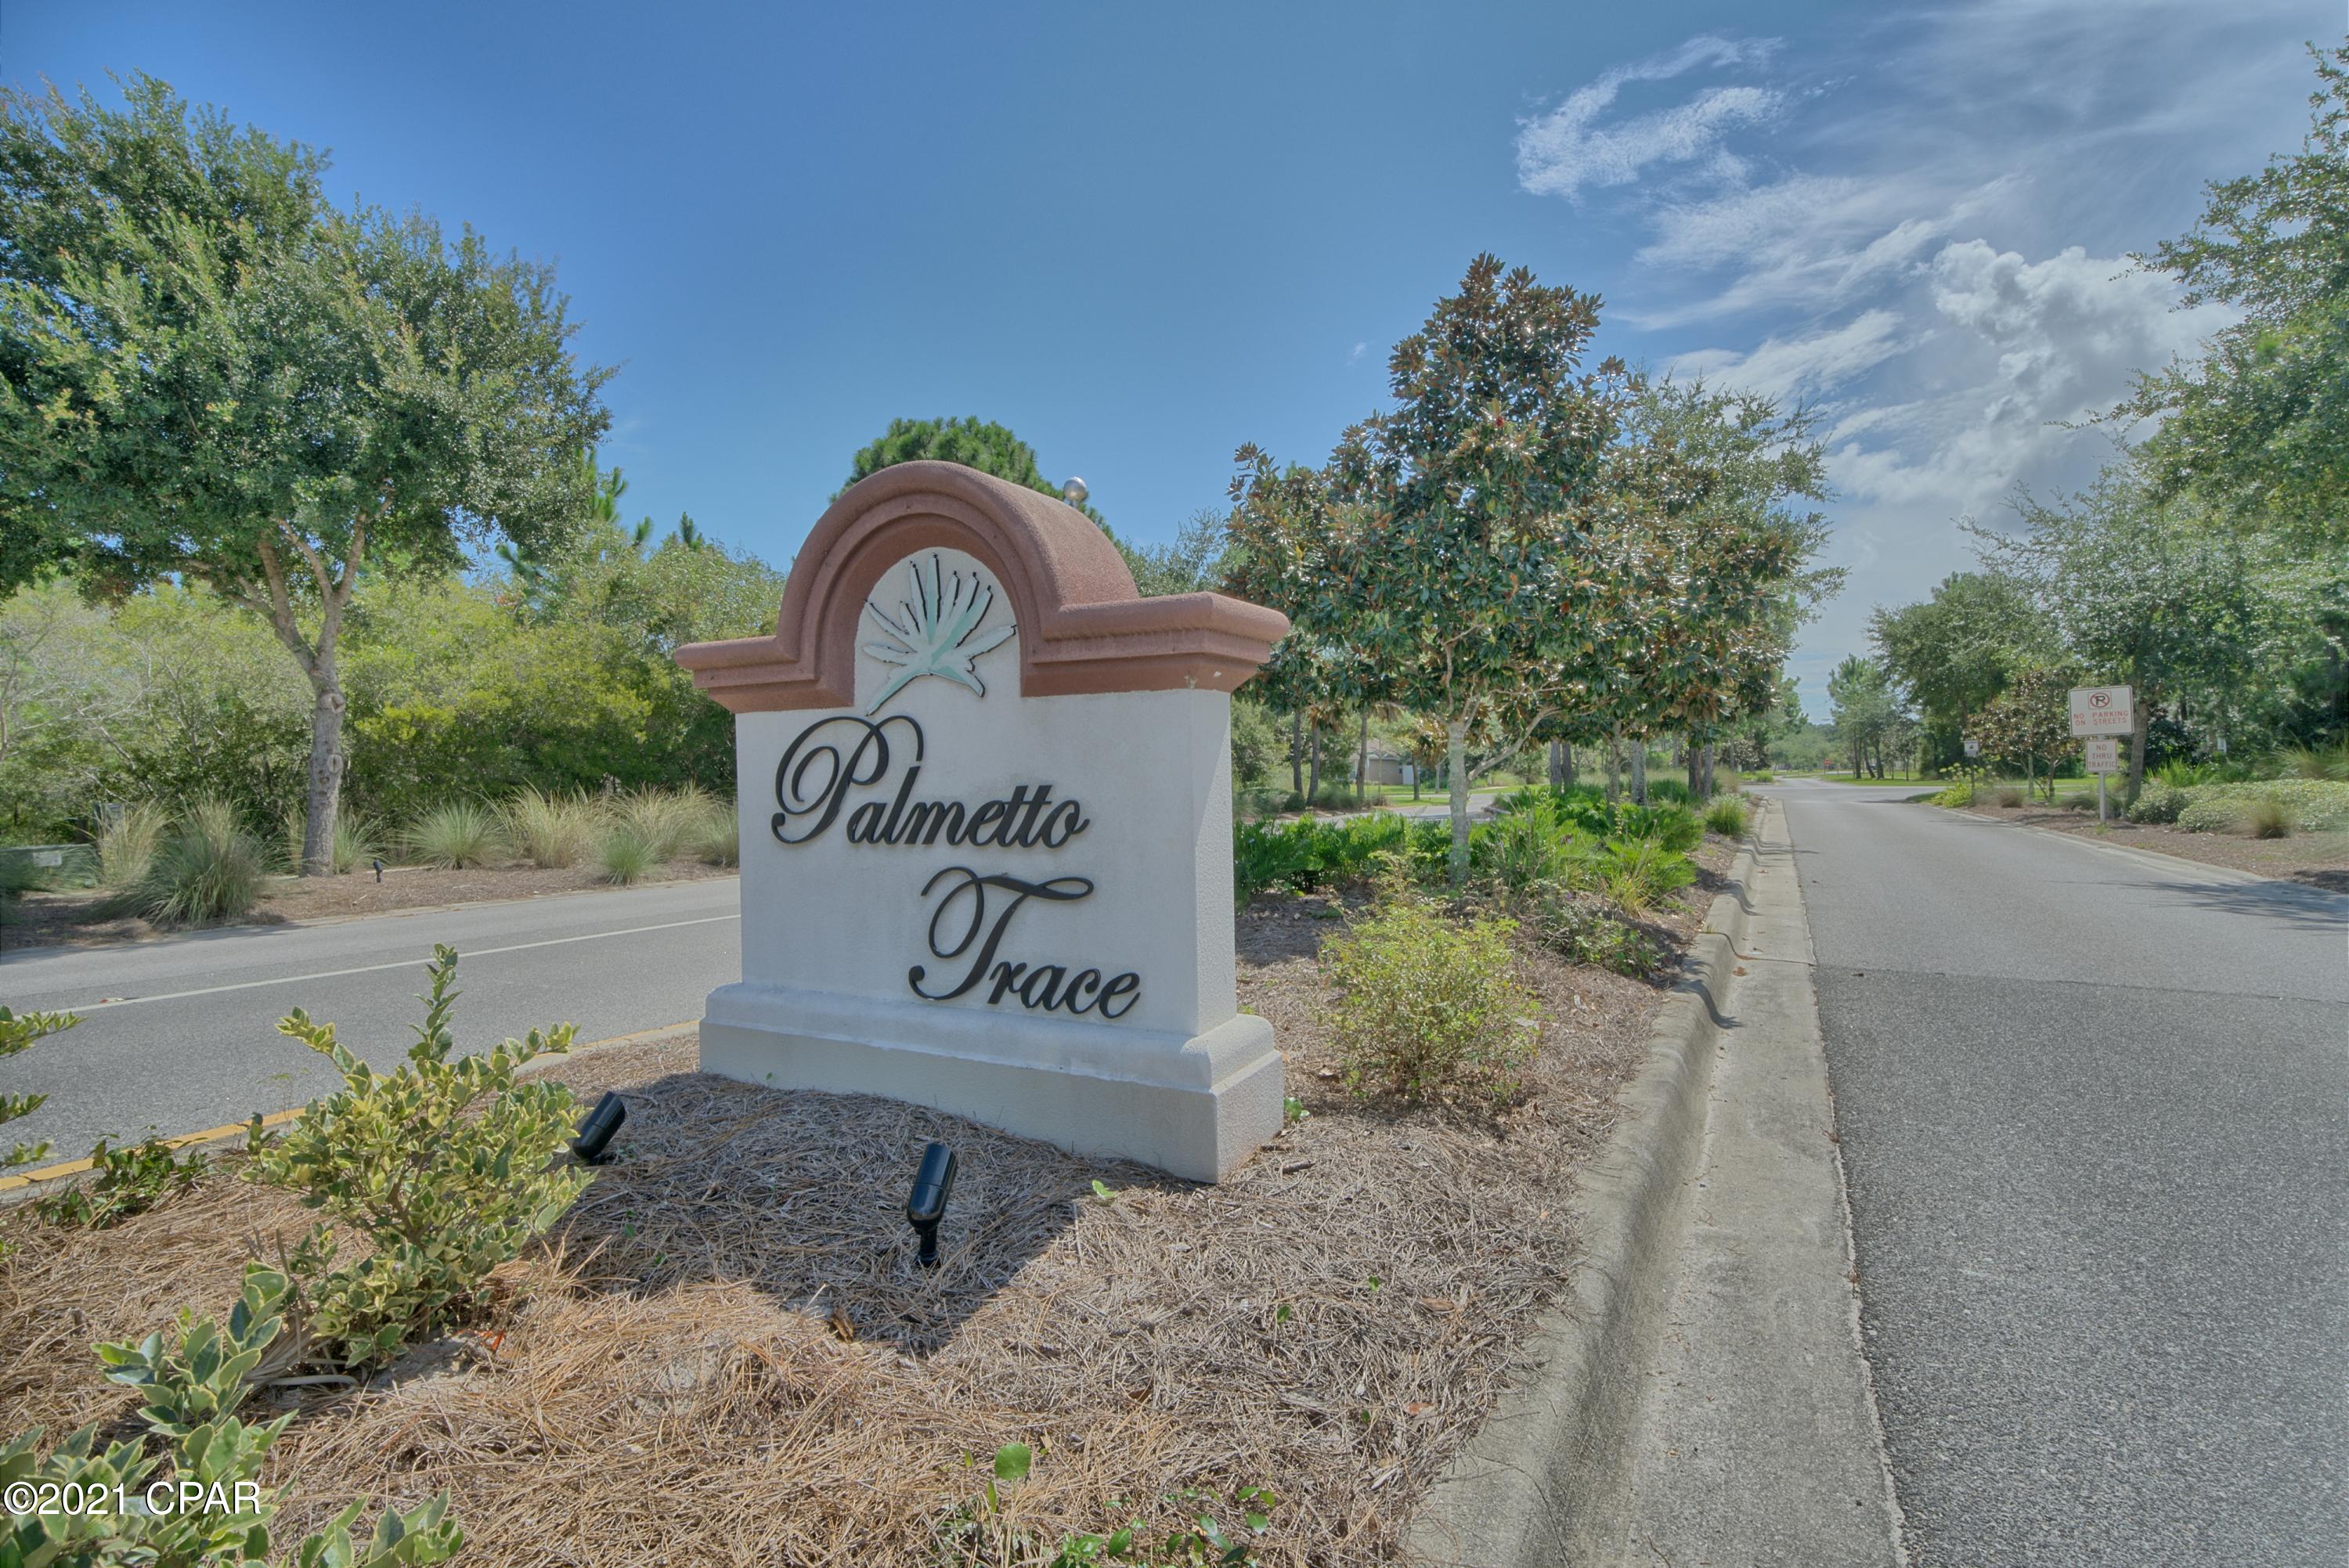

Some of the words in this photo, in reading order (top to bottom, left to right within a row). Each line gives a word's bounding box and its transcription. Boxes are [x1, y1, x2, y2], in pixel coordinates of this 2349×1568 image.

[771, 715, 1090, 849] Palmetto
[2092, 717, 2127, 726] STREETS
[908, 866, 1141, 1019] Trace
